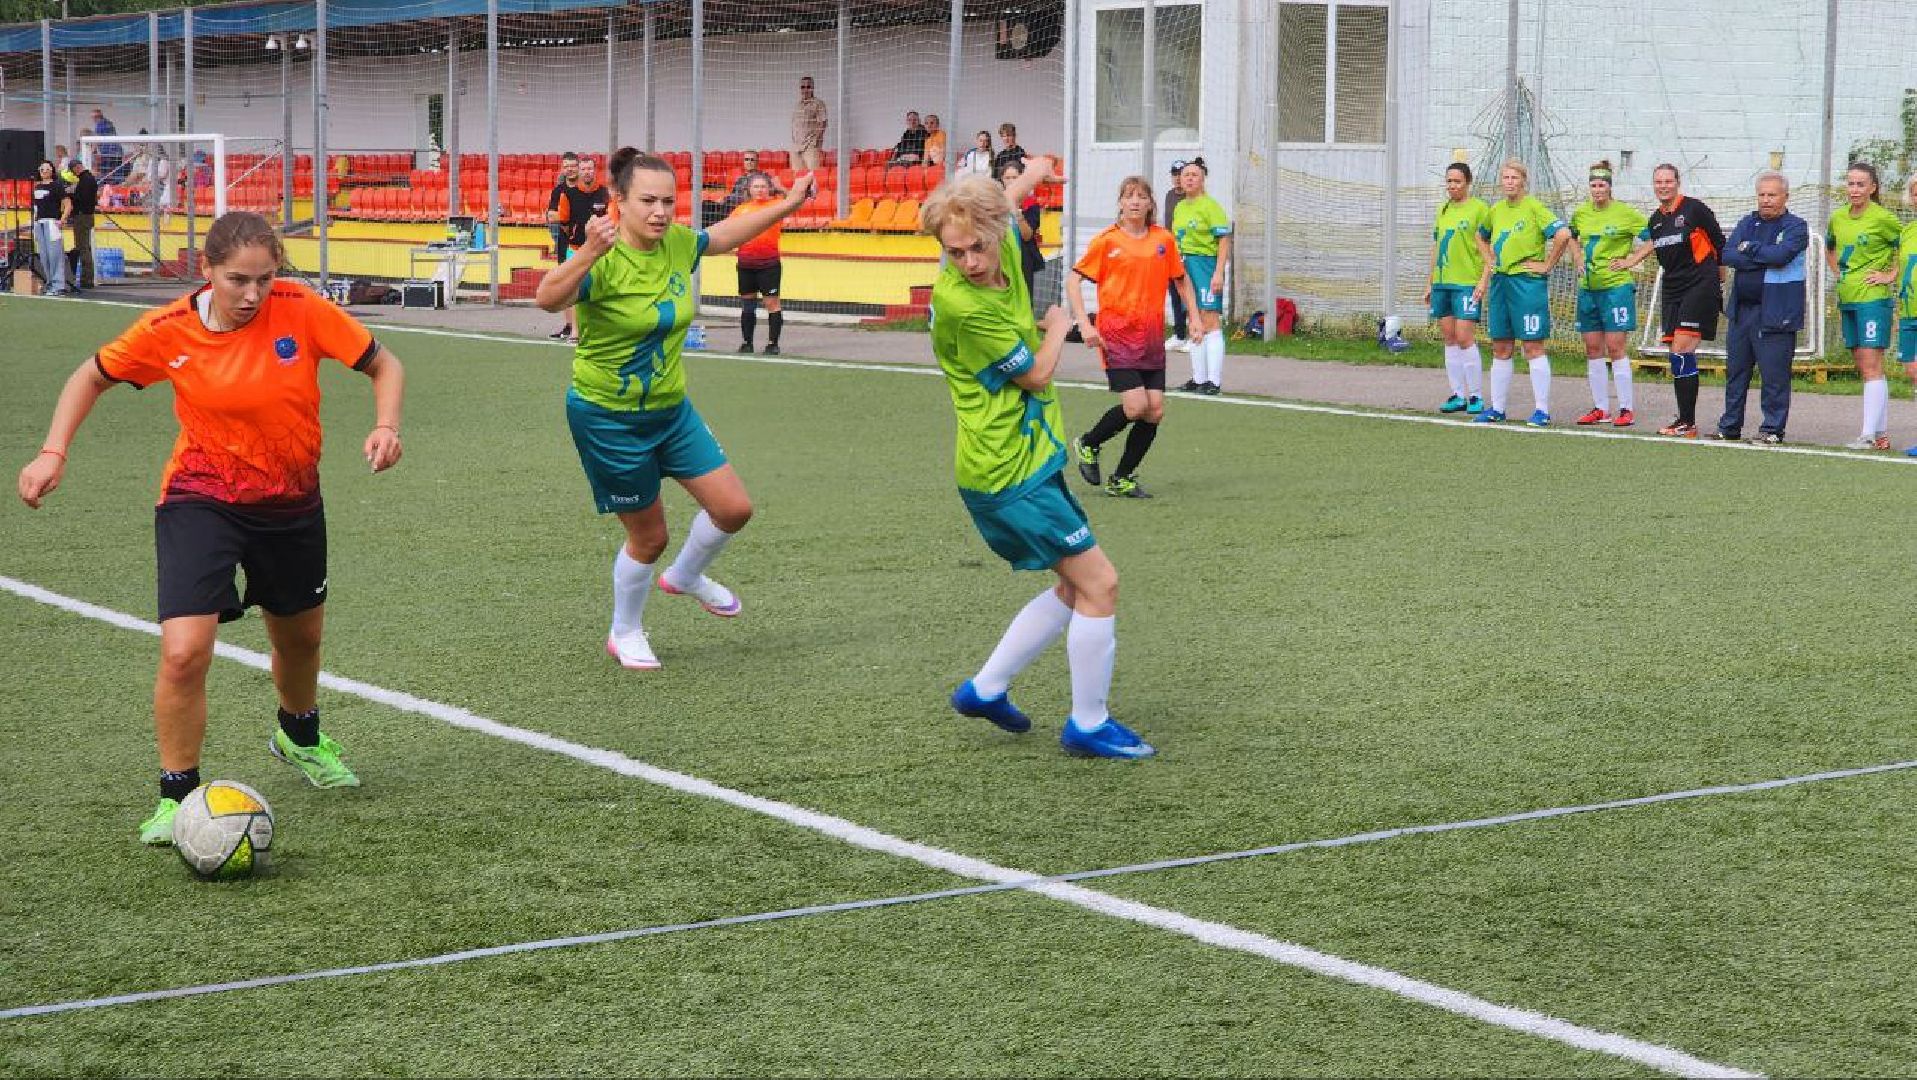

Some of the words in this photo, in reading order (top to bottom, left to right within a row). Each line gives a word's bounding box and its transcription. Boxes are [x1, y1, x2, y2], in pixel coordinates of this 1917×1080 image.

[1462, 296, 1476, 311] 12
[1523, 314, 1540, 331] 10
[1612, 307, 1629, 323] 13
[1866, 320, 1876, 338] 8
